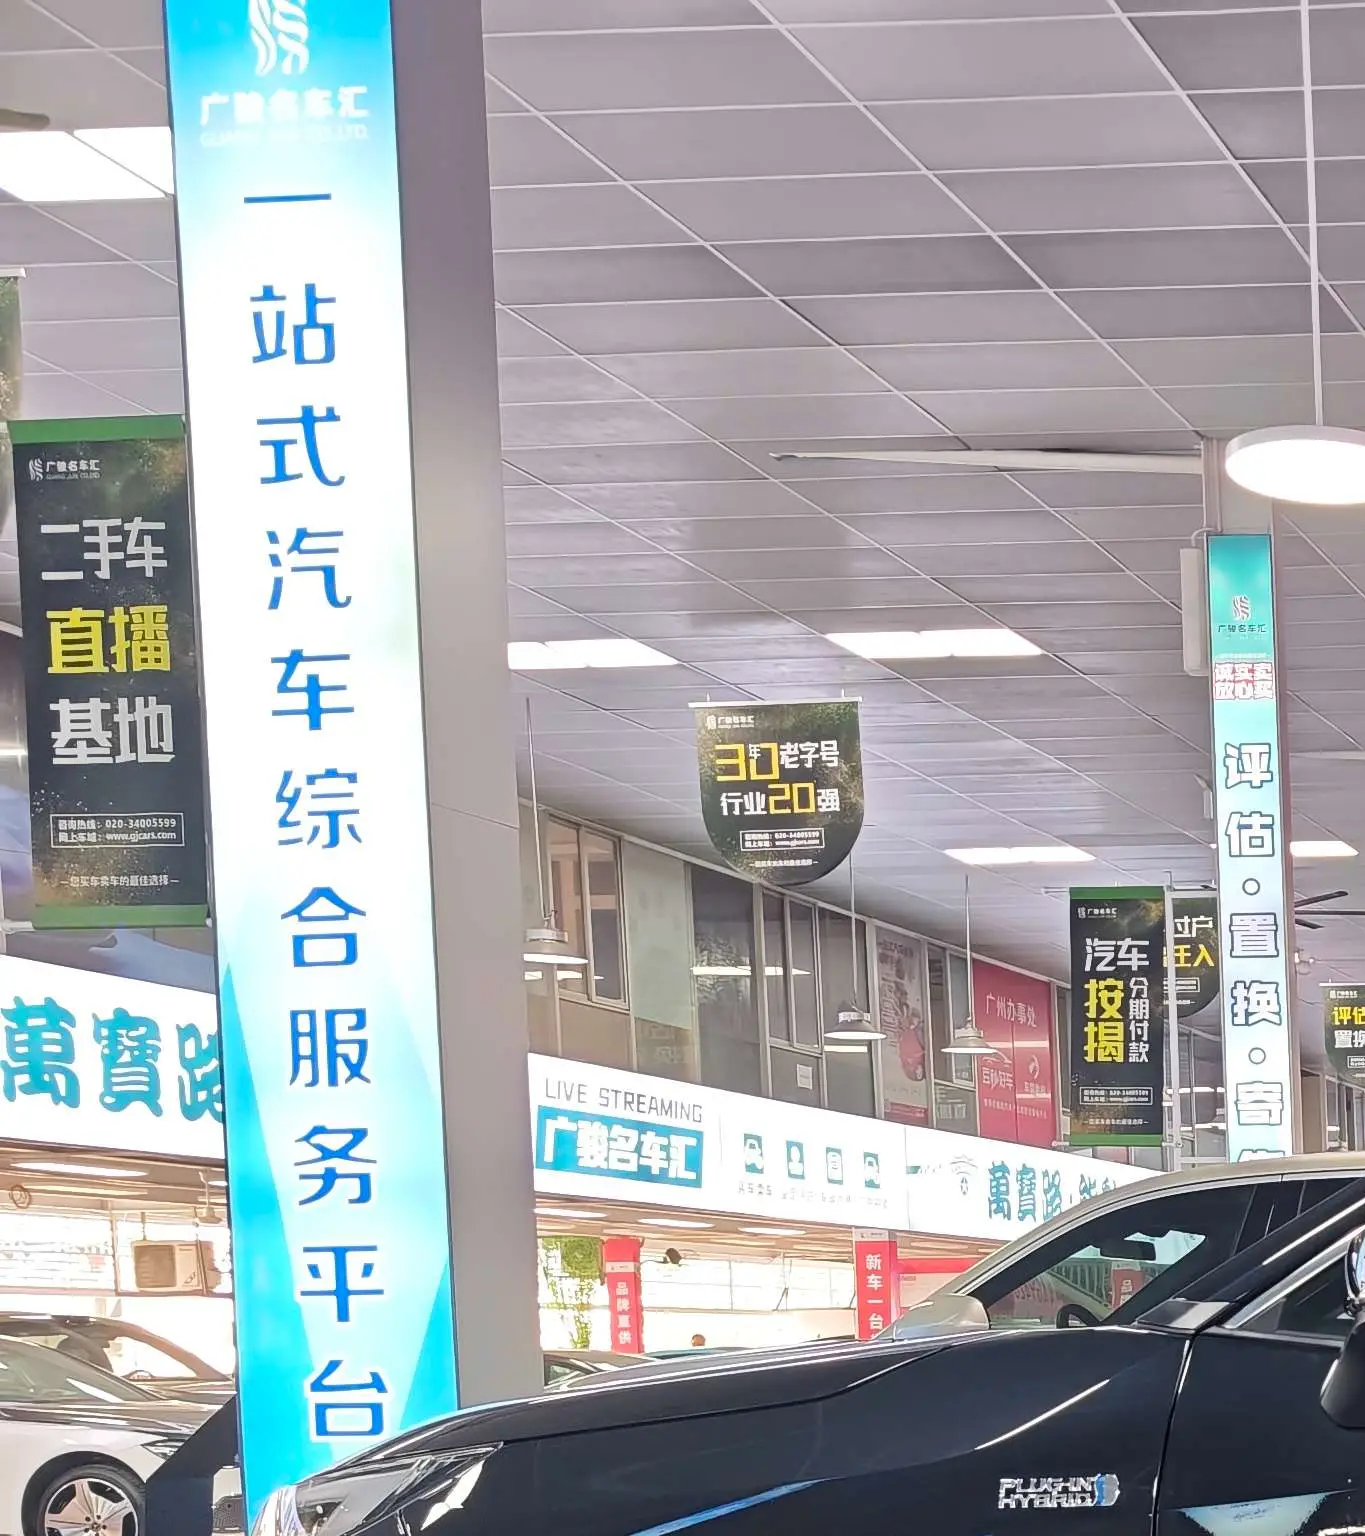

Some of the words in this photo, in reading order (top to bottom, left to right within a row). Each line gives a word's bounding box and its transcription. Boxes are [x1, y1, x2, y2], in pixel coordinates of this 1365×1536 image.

[40, 516, 168, 581] 二手车
[46, 604, 170, 675] 直播
[50, 696, 176, 764] 基地
[105, 818, 177, 829] 020-34005599
[244, 193, 386, 1437] 一站式汽车综合服务平台
[719, 781, 841, 816] 行业20强
[1084, 937, 1150, 972] 汽车
[985, 992, 1038, 1028] 广州办事处
[1083, 977, 1125, 1064] 按揭
[1128, 976, 1150, 1064] 分期付款
[545, 1077, 588, 1104] LIVE
[599, 1087, 703, 1123] STREAMING
[543, 1116, 698, 1180] 广骏名车汇
[998, 1492, 1095, 1509] HYBRID
